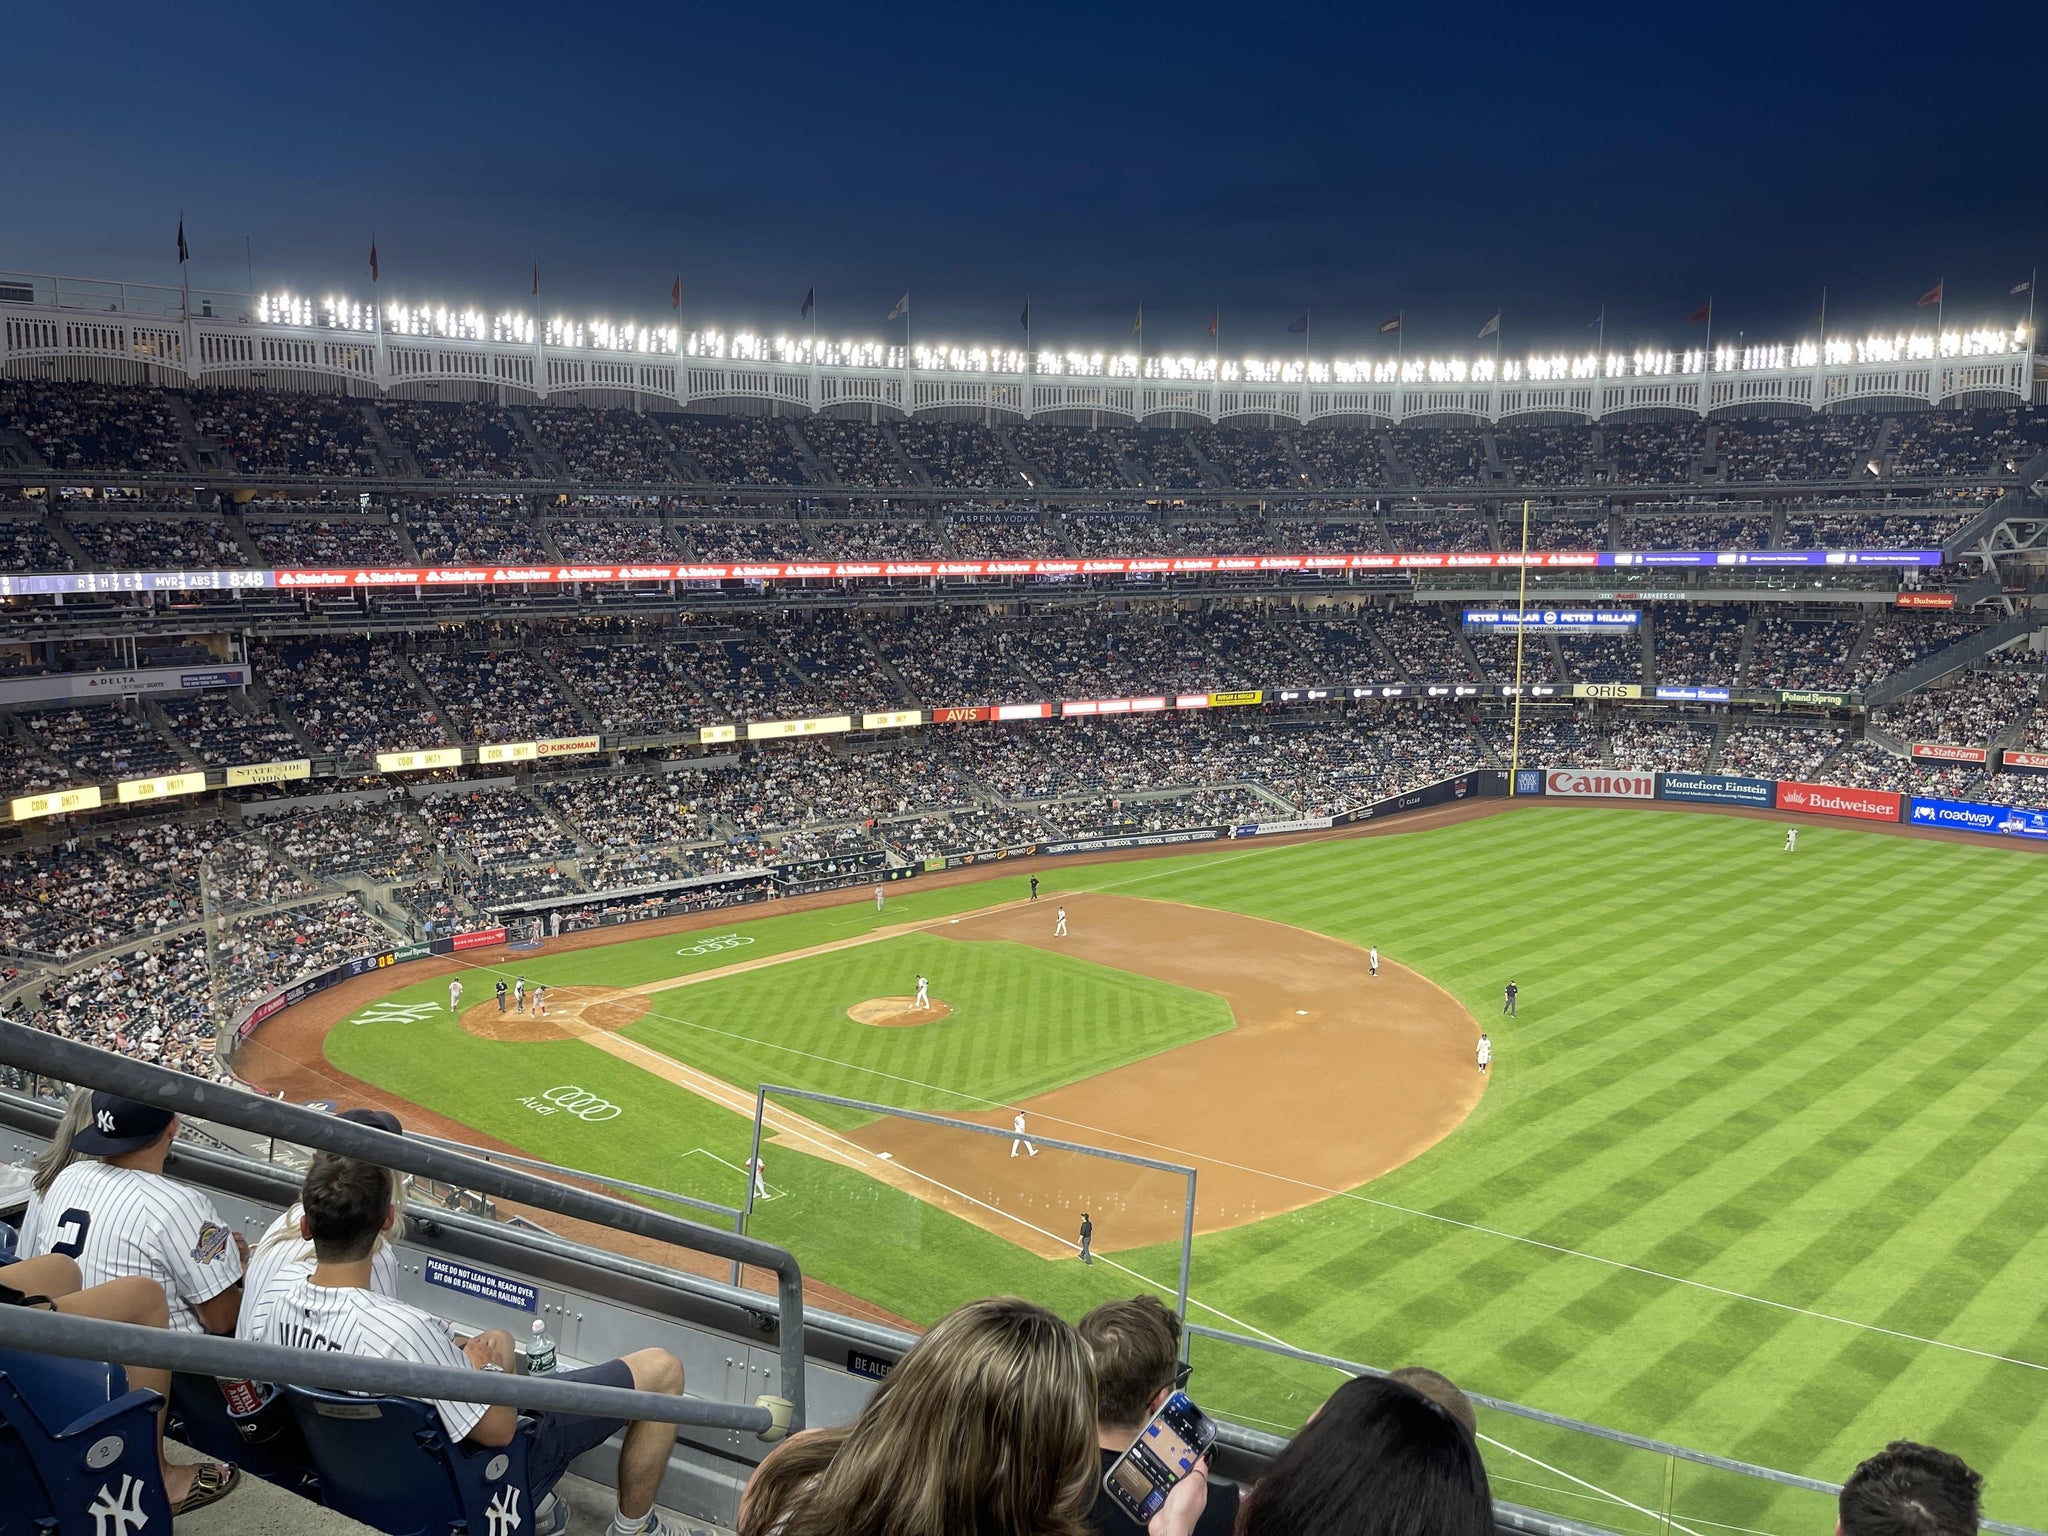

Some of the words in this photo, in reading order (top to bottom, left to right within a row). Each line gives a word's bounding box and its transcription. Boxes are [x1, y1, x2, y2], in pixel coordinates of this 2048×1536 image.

[959, 515, 992, 523] ASPEN
[1003, 515, 1036, 523] VODKA
[78, 579, 85, 588] R
[101, 578, 109, 587] H
[124, 578, 131, 587] E
[156, 577, 178, 586] MVR
[190, 576, 211, 585] ABS
[230, 572, 264, 586] 8:48
[1913, 596, 1953, 605] Budweiser
[1468, 613, 1499, 622] PETER
[1561, 613, 1593, 622] PETER
[1597, 613, 1637, 622] MILLAR
[100, 677, 136, 685] DELTA
[1586, 685, 1628, 697] ORIS
[1782, 692, 1812, 702] Poland
[1812, 693, 1842, 705] Spring
[946, 708, 977, 721] AVIS
[551, 741, 597, 752] KIKKOMAN
[2029, 756, 2048, 766] Stat
[236, 763, 303, 777] STATESIDE
[251, 773, 289, 784] VODKA
[1548, 771, 1652, 796] Canon
[138, 783, 155, 795] COOK
[167, 779, 185, 790] UNITY
[1665, 778, 1723, 791] Montefiore
[1725, 781, 1767, 794] Einstein
[31, 801, 49, 812] COOK
[62, 795, 80, 807] UNITY
[1939, 809, 1995, 827] roadway
[978, 853, 996, 861] PREMIO
[1008, 848, 1026, 856] PREMIO
[515, 1096, 559, 1116] Audi
[50, 1208, 92, 1259] 2
[428, 1259, 449, 1273] PLEASE
[449, 1266, 458, 1275] DO
[458, 1268, 470, 1278] NOT
[471, 1271, 485, 1283] LEAN
[486, 1276, 497, 1288] ON,
[497, 1279, 517, 1293] REACH
[518, 1286, 535, 1299] OVER,
[433, 1272, 443, 1281] SIT
[443, 1275, 452, 1283] ON
[453, 1278, 462, 1286] OR
[461, 1280, 481, 1293] STAND
[481, 1286, 497, 1297] NEAR
[498, 1290, 527, 1307] RAILINGS.
[854, 1357, 867, 1371] BE
[227, 1389, 246, 1413] ARTO
[237, 1384, 256, 1412] STELL
[99, 1445, 111, 1460] 2
[493, 1463, 502, 1473] 1
